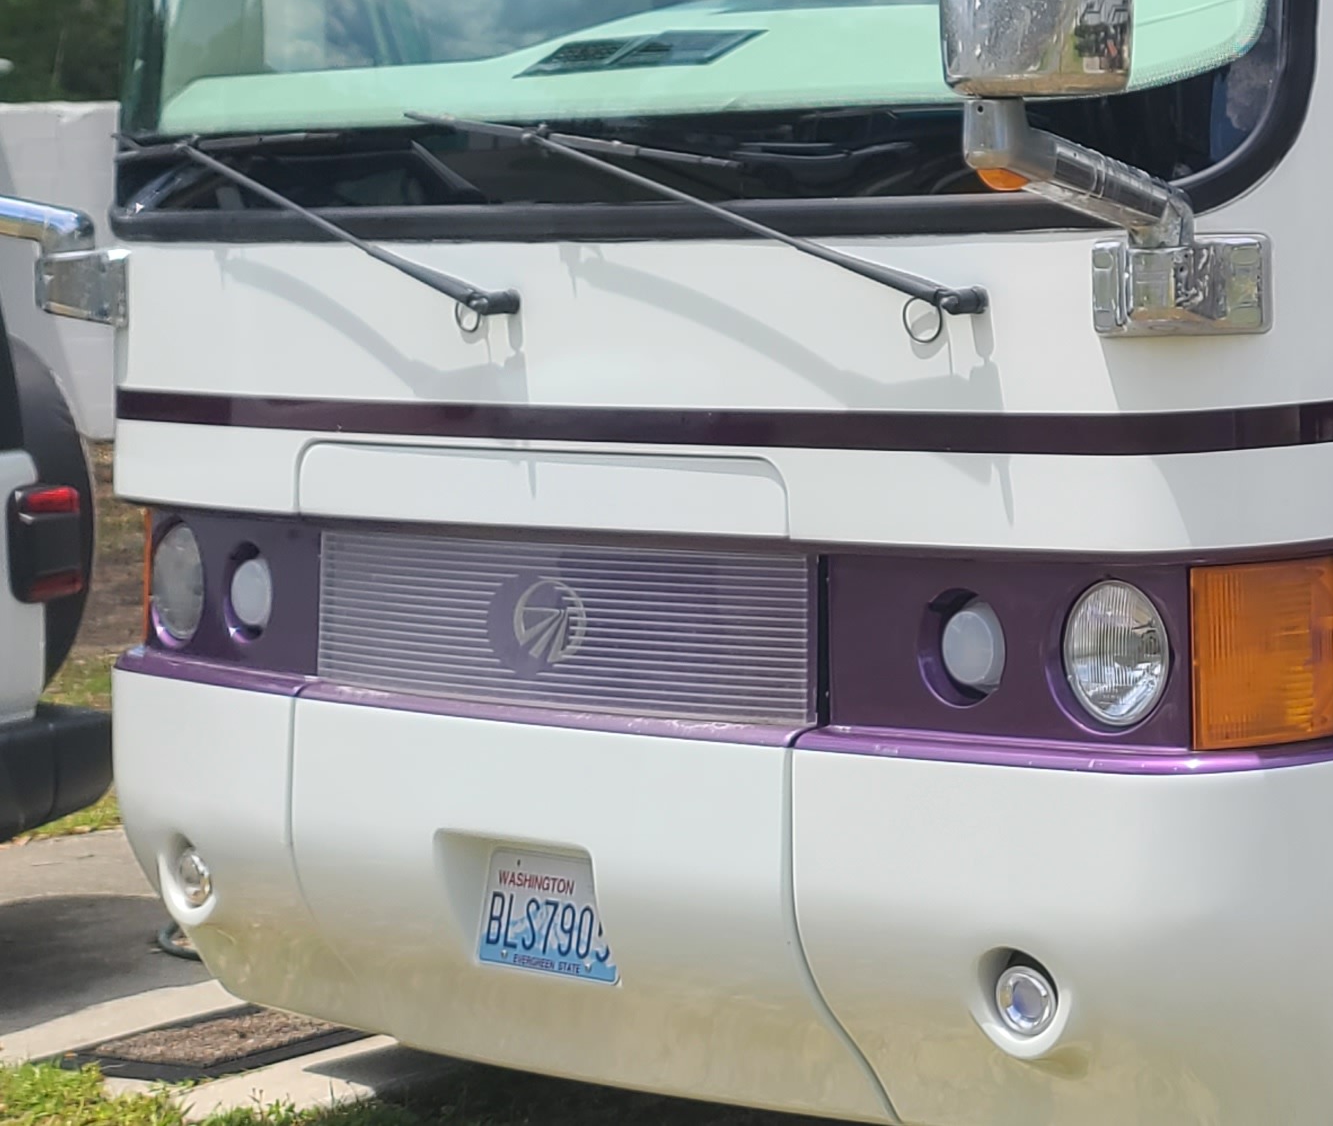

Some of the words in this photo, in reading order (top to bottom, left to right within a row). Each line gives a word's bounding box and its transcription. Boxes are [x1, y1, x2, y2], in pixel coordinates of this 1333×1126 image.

[498, 869, 575, 895] WASHINGTON
[512, 953, 555, 970] EVERGREEN
[557, 961, 582, 975] STATE
